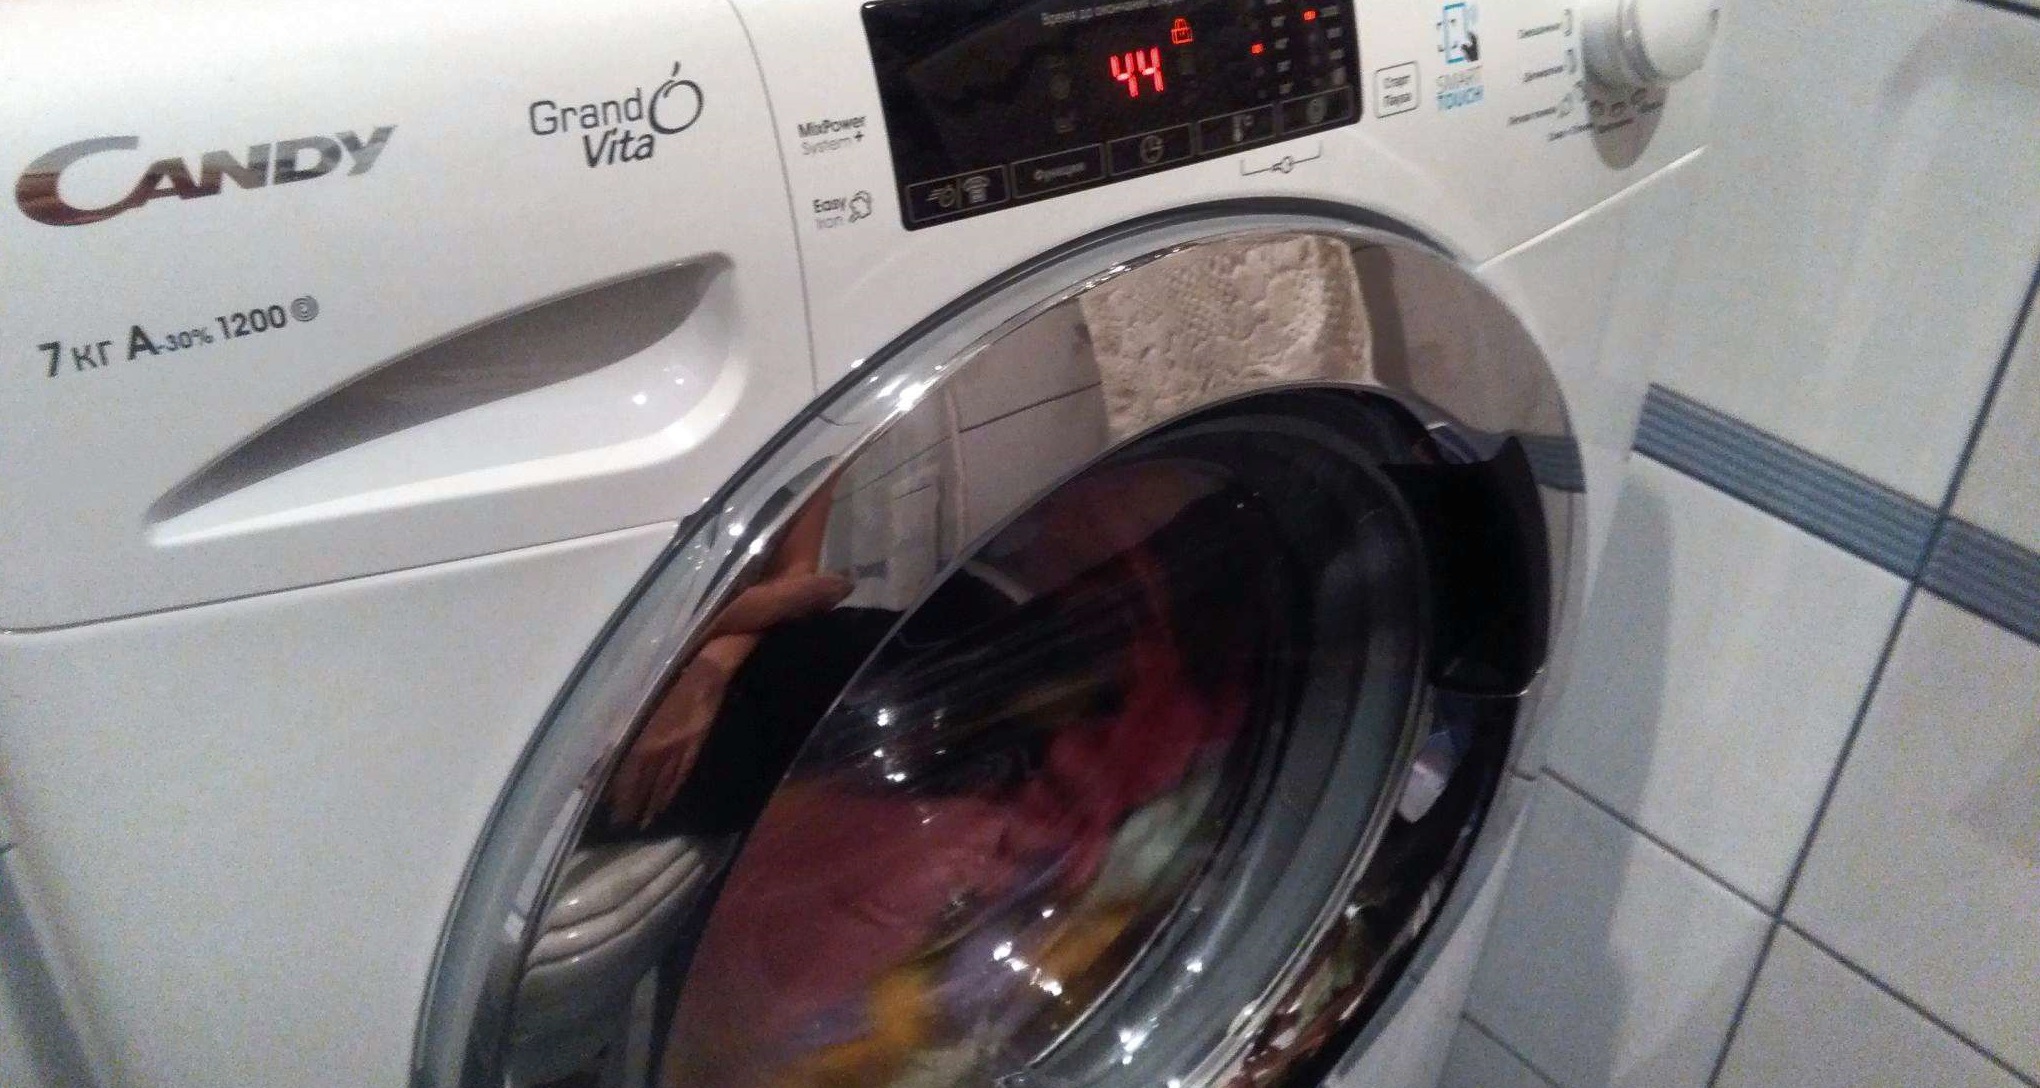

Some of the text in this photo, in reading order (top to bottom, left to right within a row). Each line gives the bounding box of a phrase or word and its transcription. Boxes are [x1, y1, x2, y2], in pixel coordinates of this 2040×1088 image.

[1110, 47, 1164, 97] 44
[797, 115, 867, 138] MixPower
[582, 127, 656, 168] Vita
[813, 198, 847, 214] Easy
[215, 304, 288, 340] 1200
